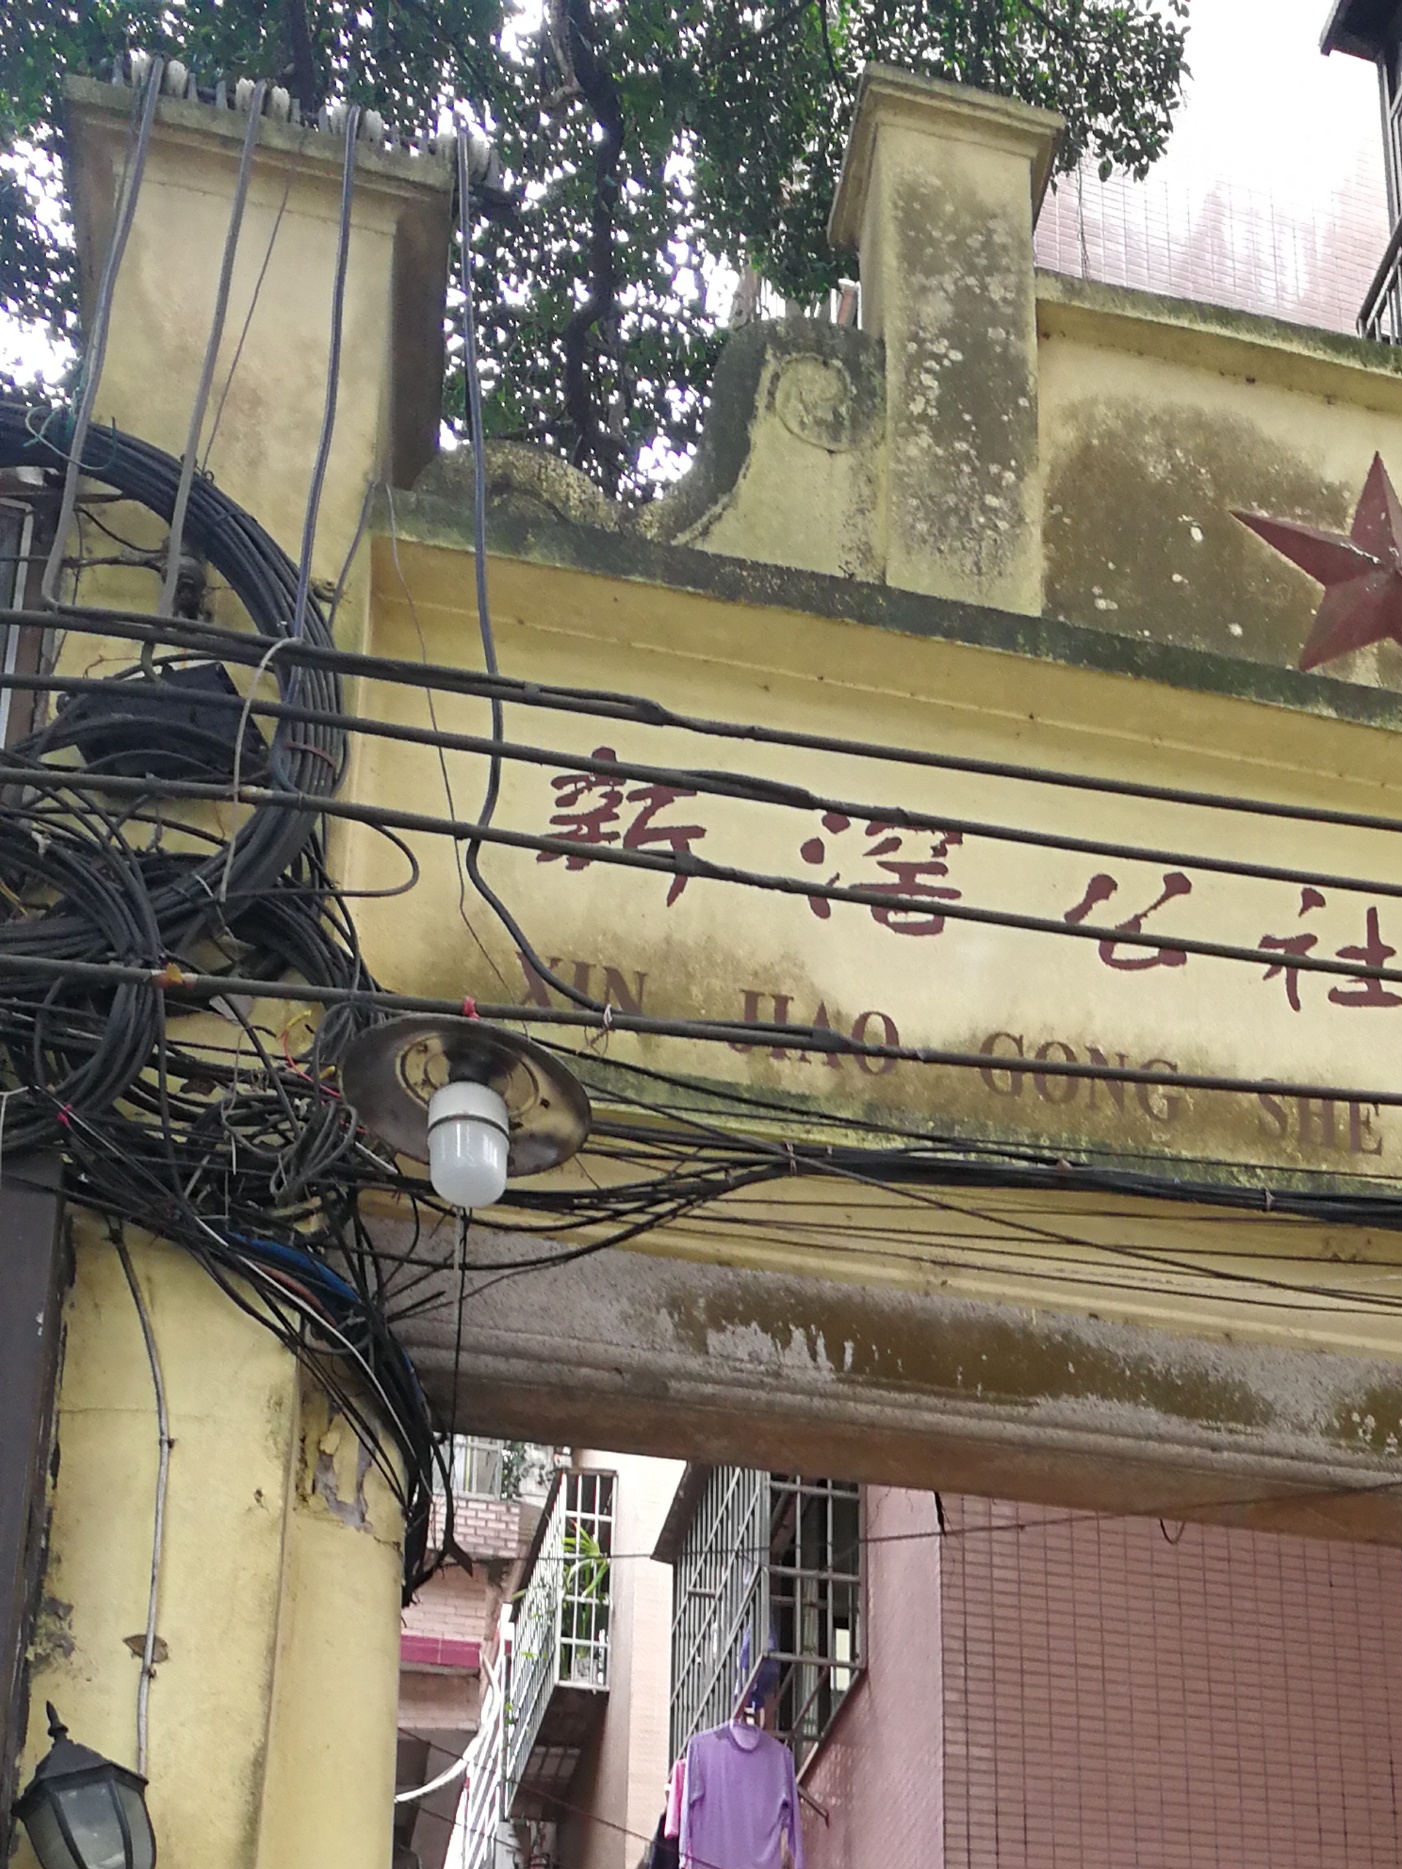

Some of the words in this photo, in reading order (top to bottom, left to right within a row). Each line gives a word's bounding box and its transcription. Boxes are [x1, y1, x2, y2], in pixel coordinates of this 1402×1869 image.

[516, 950, 649, 1036] XIN
[978, 1031, 1183, 1123] GONG
[1258, 1077, 1382, 1157] SHE
